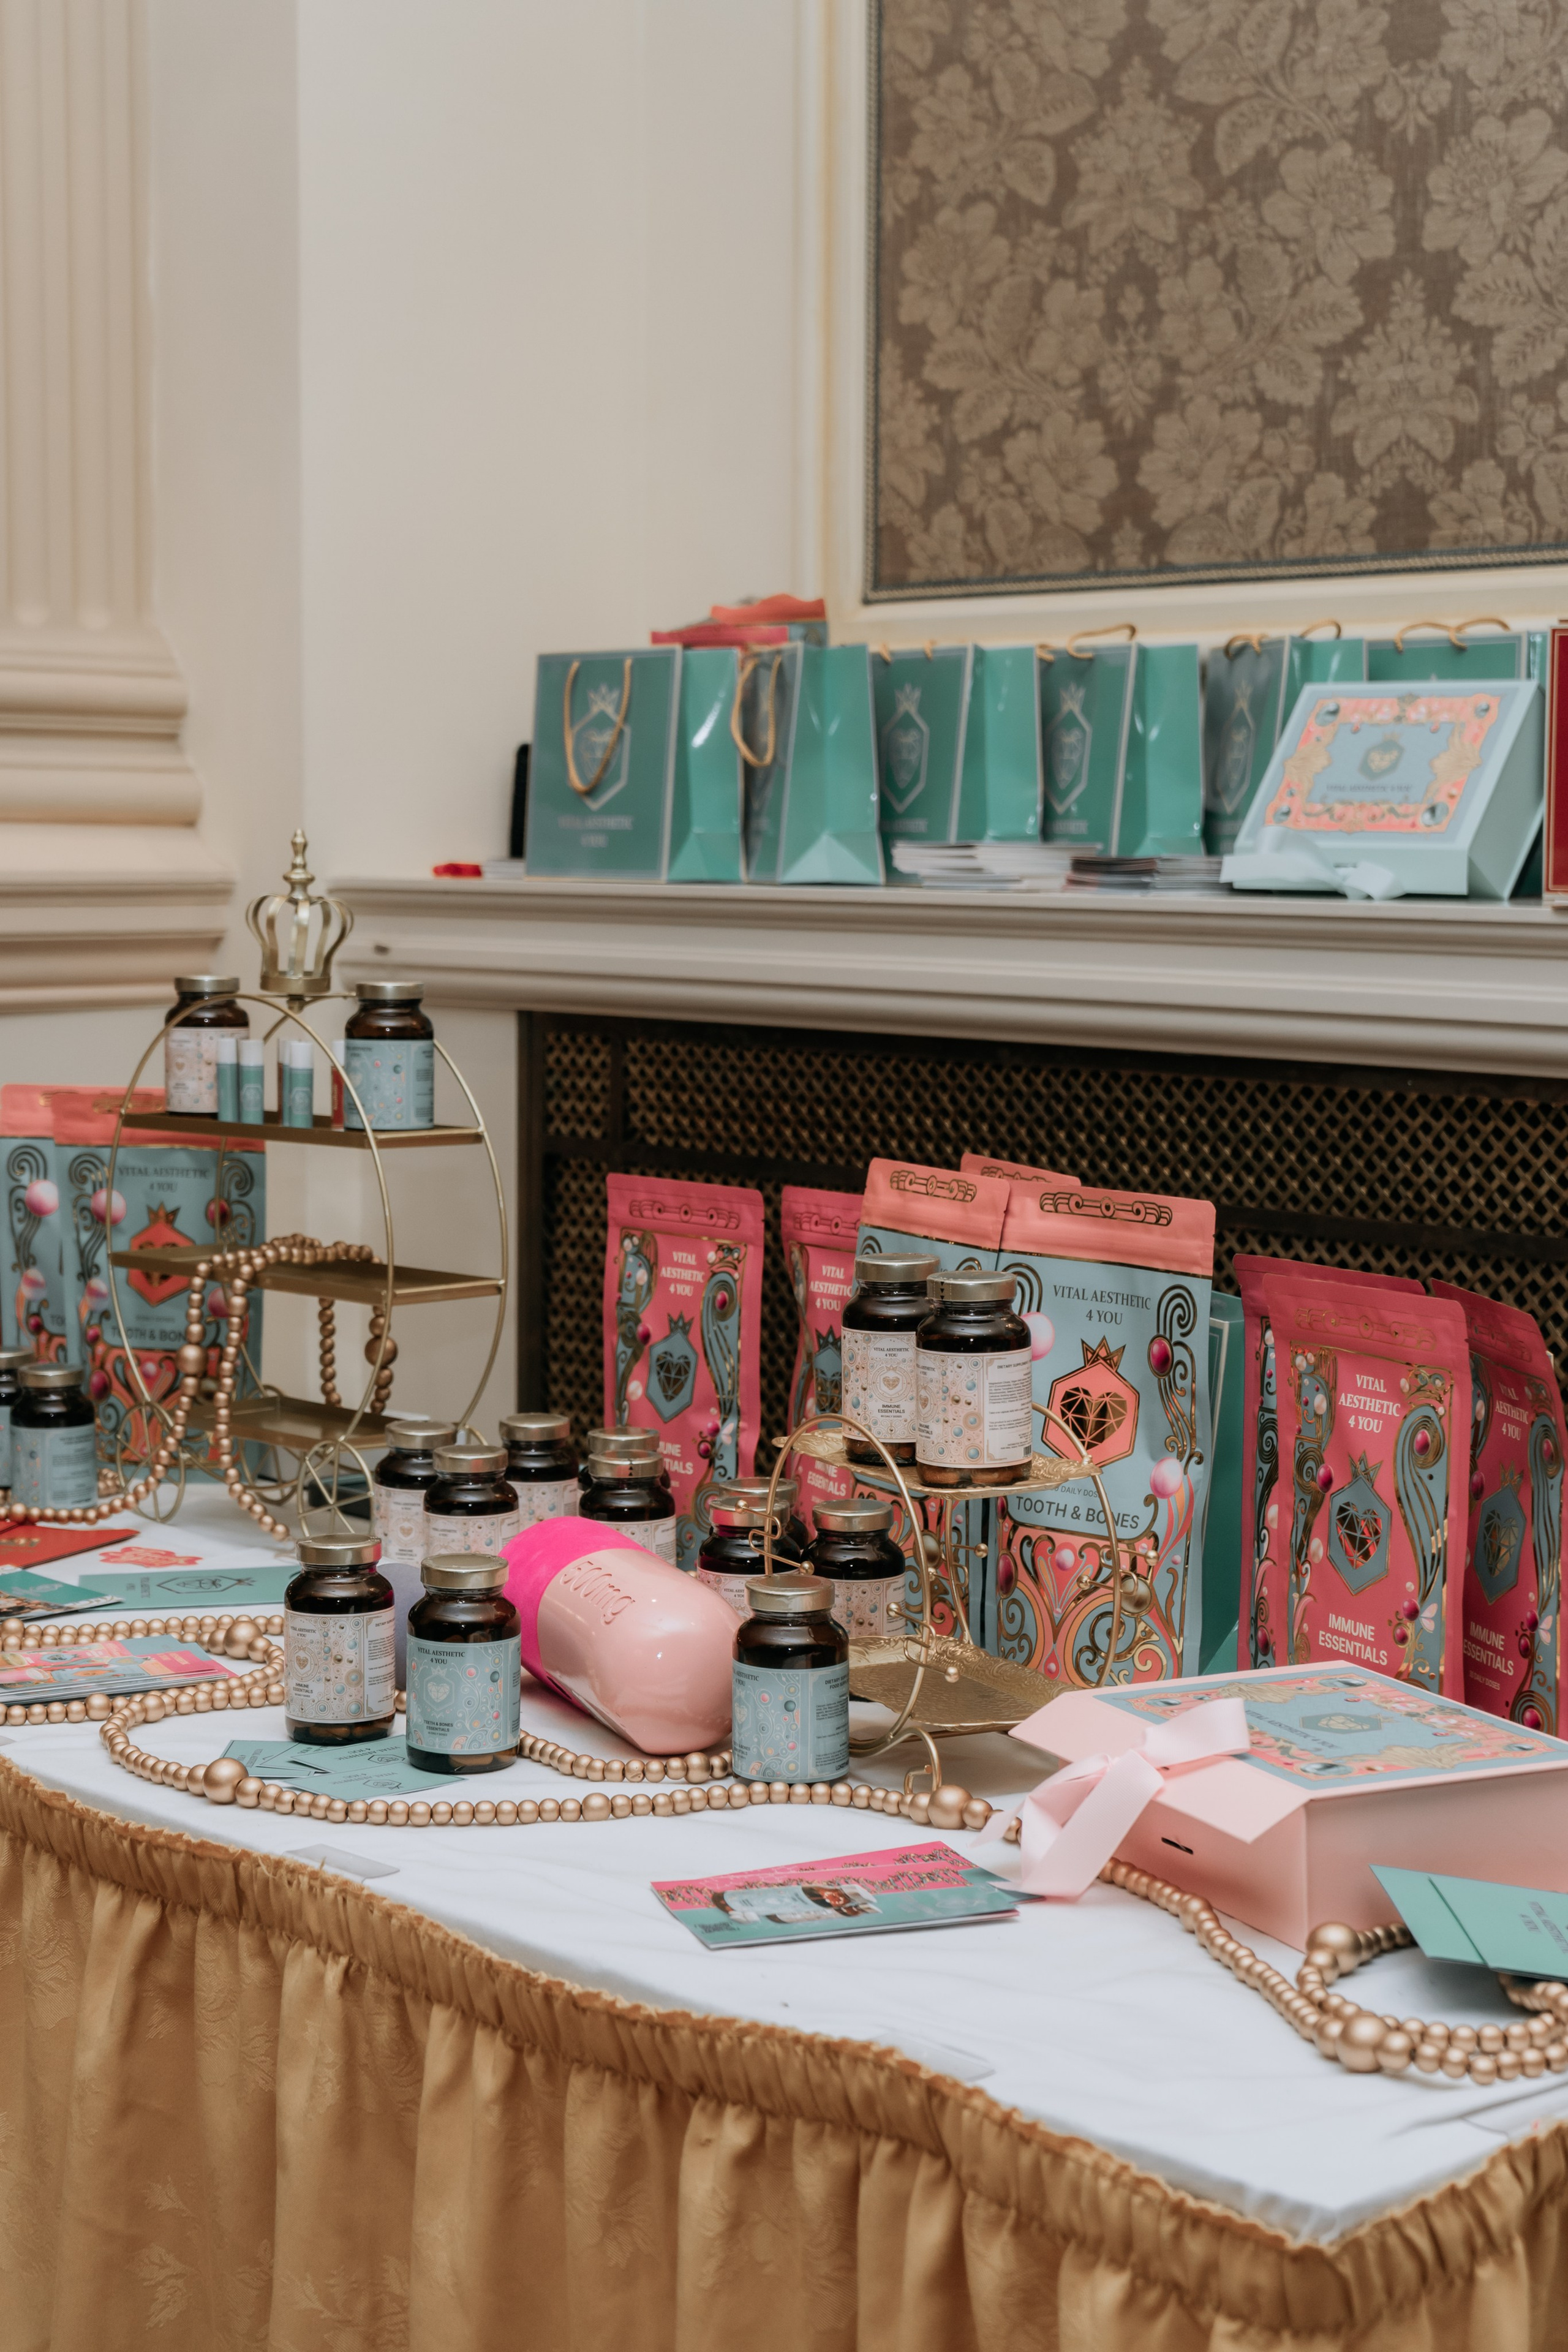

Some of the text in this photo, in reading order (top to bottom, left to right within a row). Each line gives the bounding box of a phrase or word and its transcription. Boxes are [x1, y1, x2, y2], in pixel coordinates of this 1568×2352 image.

[118, 1167, 209, 1180] VITAL AESTHETIC
[157, 1182, 178, 1193] YOU
[673, 1251, 697, 1265] VITAL
[660, 1266, 705, 1283] AESTHETIC
[822, 1265, 845, 1280] VITAL
[669, 1283, 694, 1297] 4 YOU
[809, 1280, 853, 1298] AESTHETIC
[1053, 1284, 1152, 1310] VITAL AESTHETIC
[815, 1297, 842, 1312] 4 YOU
[1085, 1309, 1123, 1325] 4 YOU
[1355, 1374, 1387, 1393] VITAL
[1338, 1392, 1401, 1417] AESTHETIC
[1495, 1399, 1529, 1425] AESTHETIC
[1348, 1415, 1383, 1433] 4 YOU
[1501, 1422, 1521, 1441] 4 YOU
[1061, 1485, 1082, 1496] DAILY
[1016, 1496, 1068, 1518] TOOTH
[1071, 1506, 1081, 1521] &
[1329, 1613, 1375, 1642] IMMUNE
[1469, 1621, 1505, 1651] IMMUNE
[1319, 1630, 1388, 1665] ESSENTIALS
[1463, 1638, 1514, 1676] ESSENTIALS
